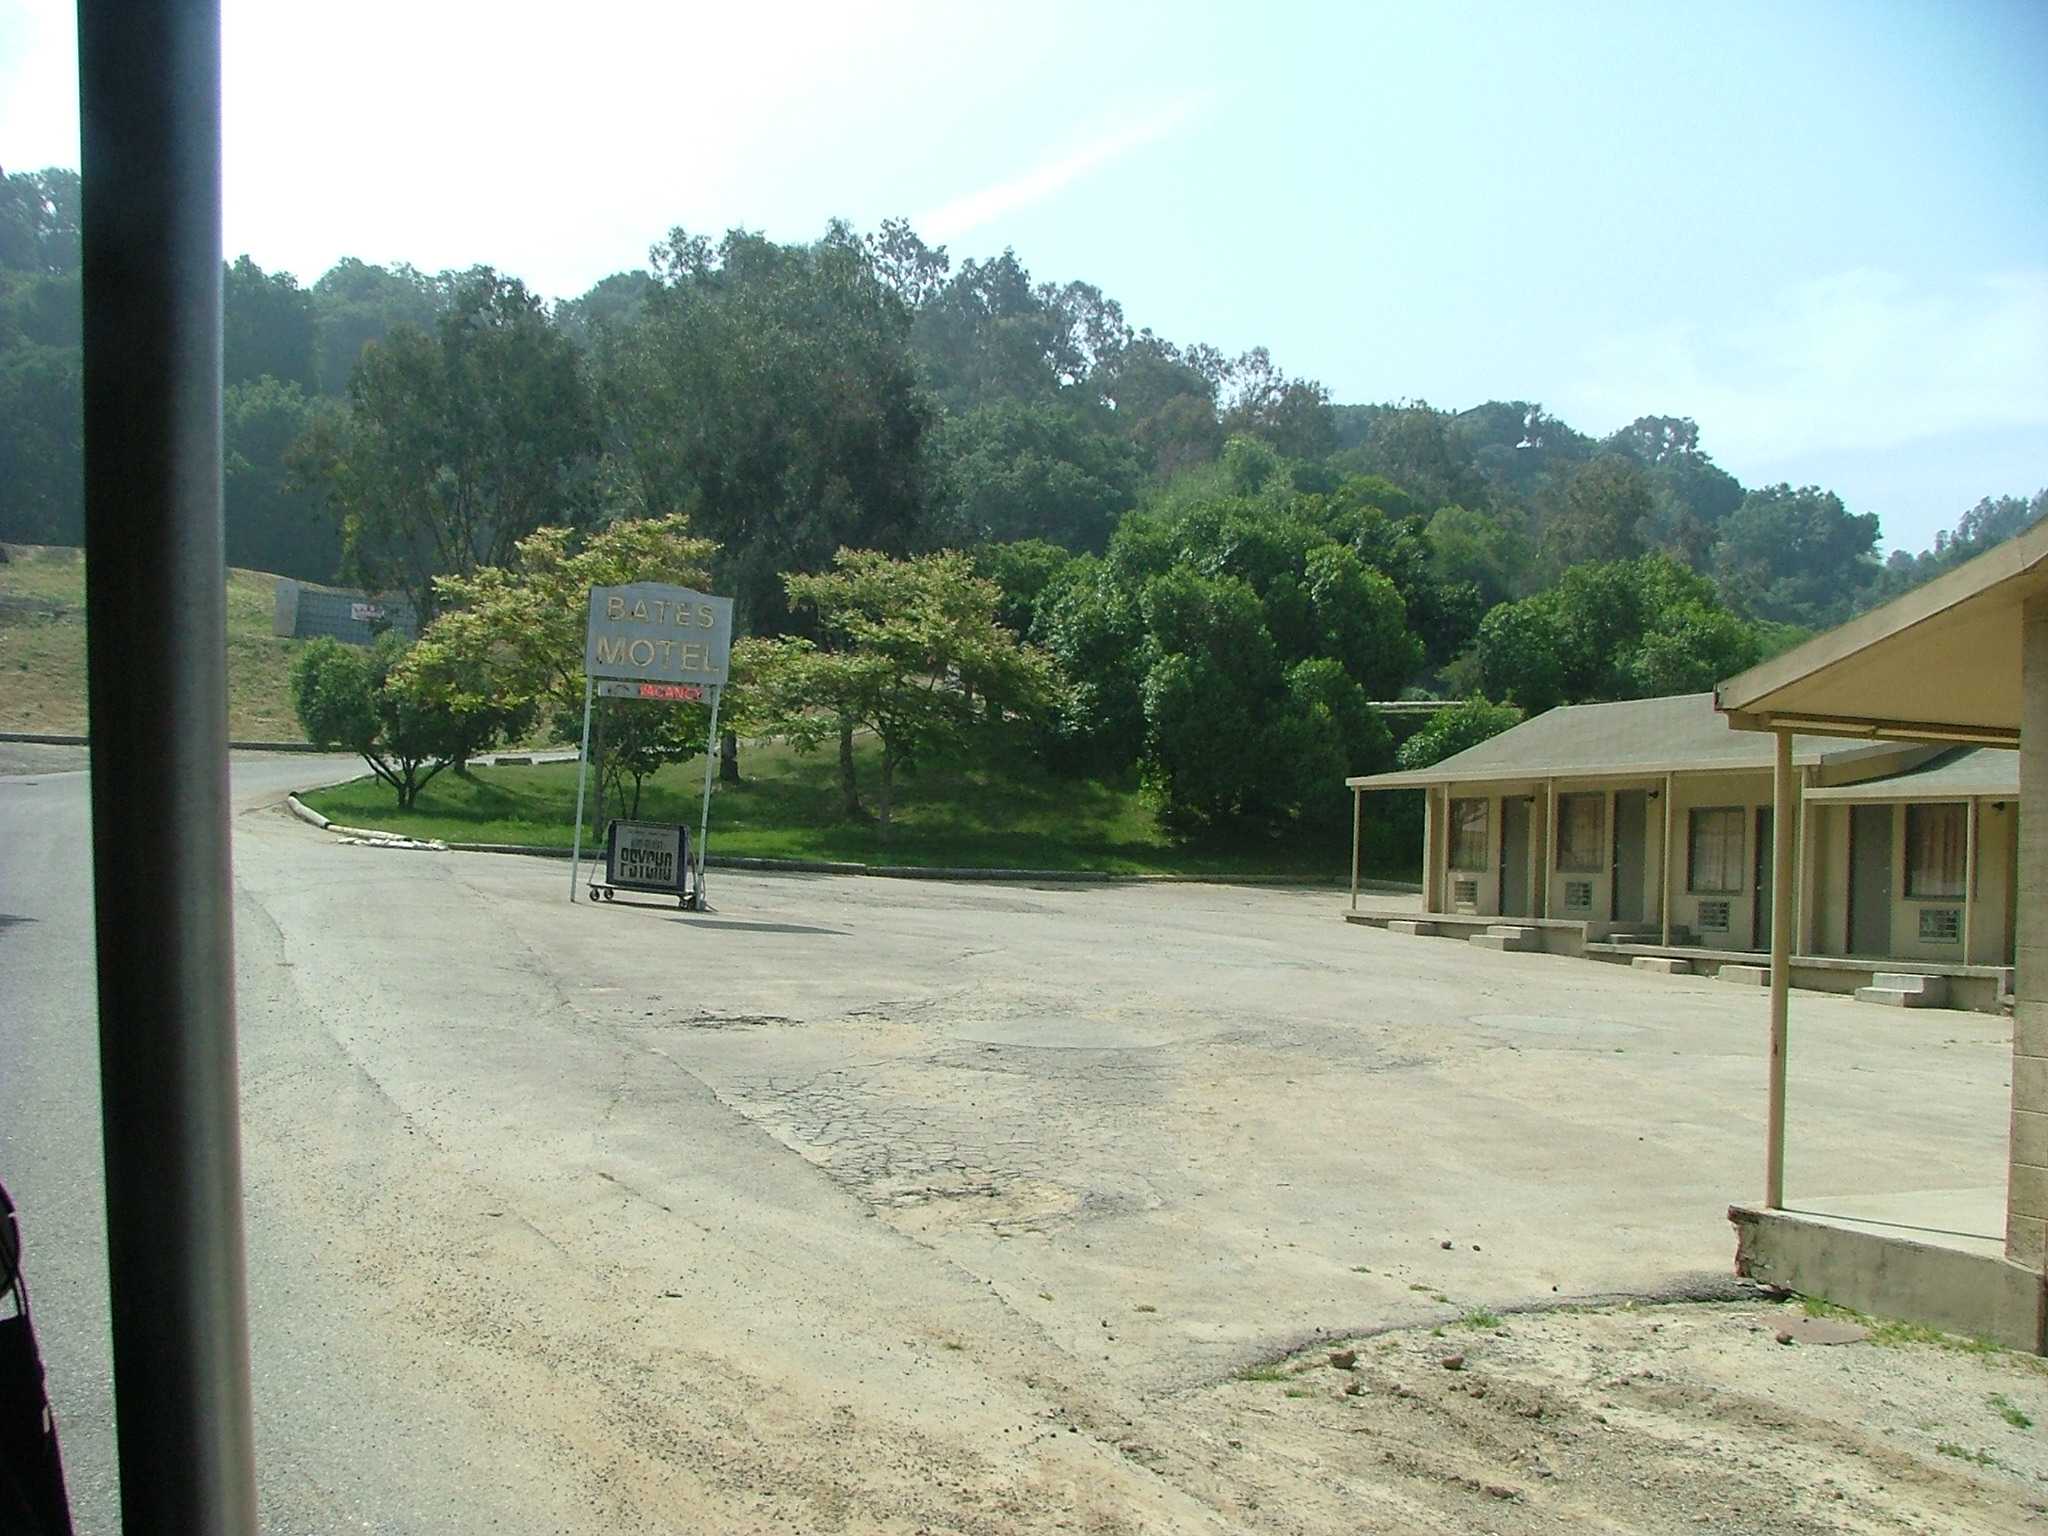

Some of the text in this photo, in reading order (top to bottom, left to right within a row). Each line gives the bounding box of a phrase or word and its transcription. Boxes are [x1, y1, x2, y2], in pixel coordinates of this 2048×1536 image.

[607, 595, 715, 629] BATES
[596, 636, 720, 673] MOTEL
[640, 684, 704, 701] VACANCY
